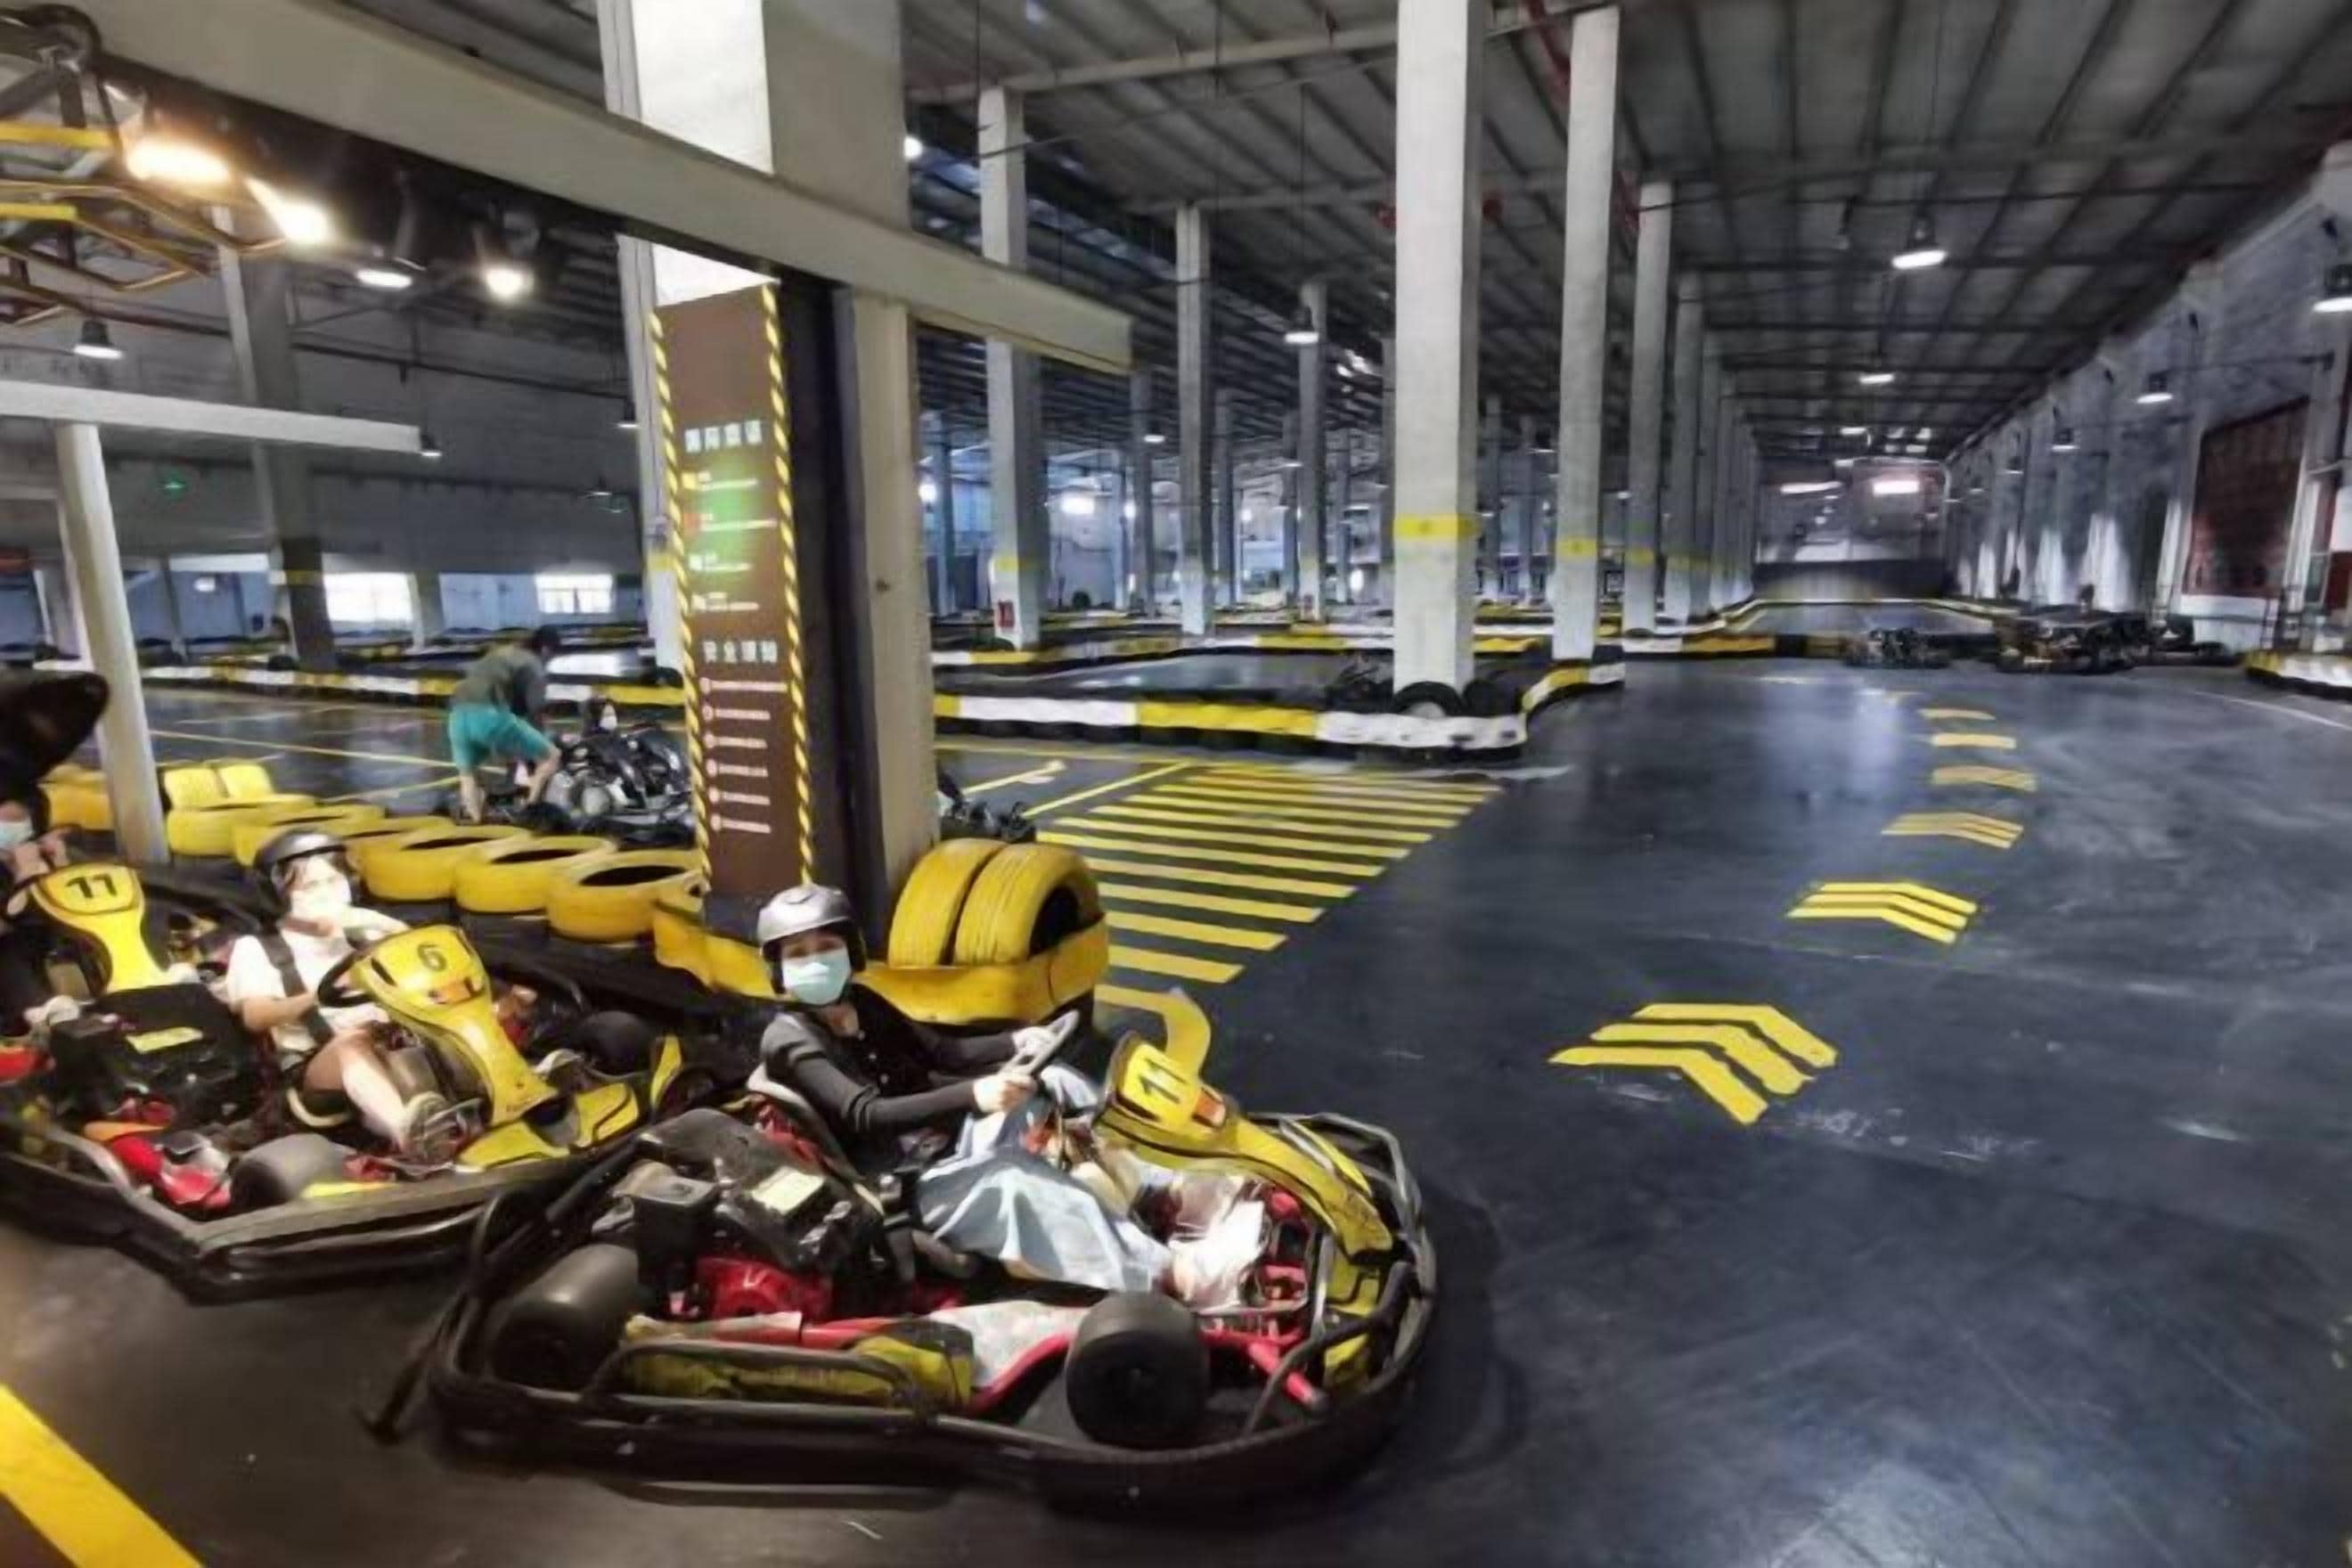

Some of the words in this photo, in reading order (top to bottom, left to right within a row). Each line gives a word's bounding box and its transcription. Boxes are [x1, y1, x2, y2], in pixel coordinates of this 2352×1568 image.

[66, 873, 118, 899] 11
[417, 942, 447, 971] 6
[1139, 1057, 1191, 1106] 11
